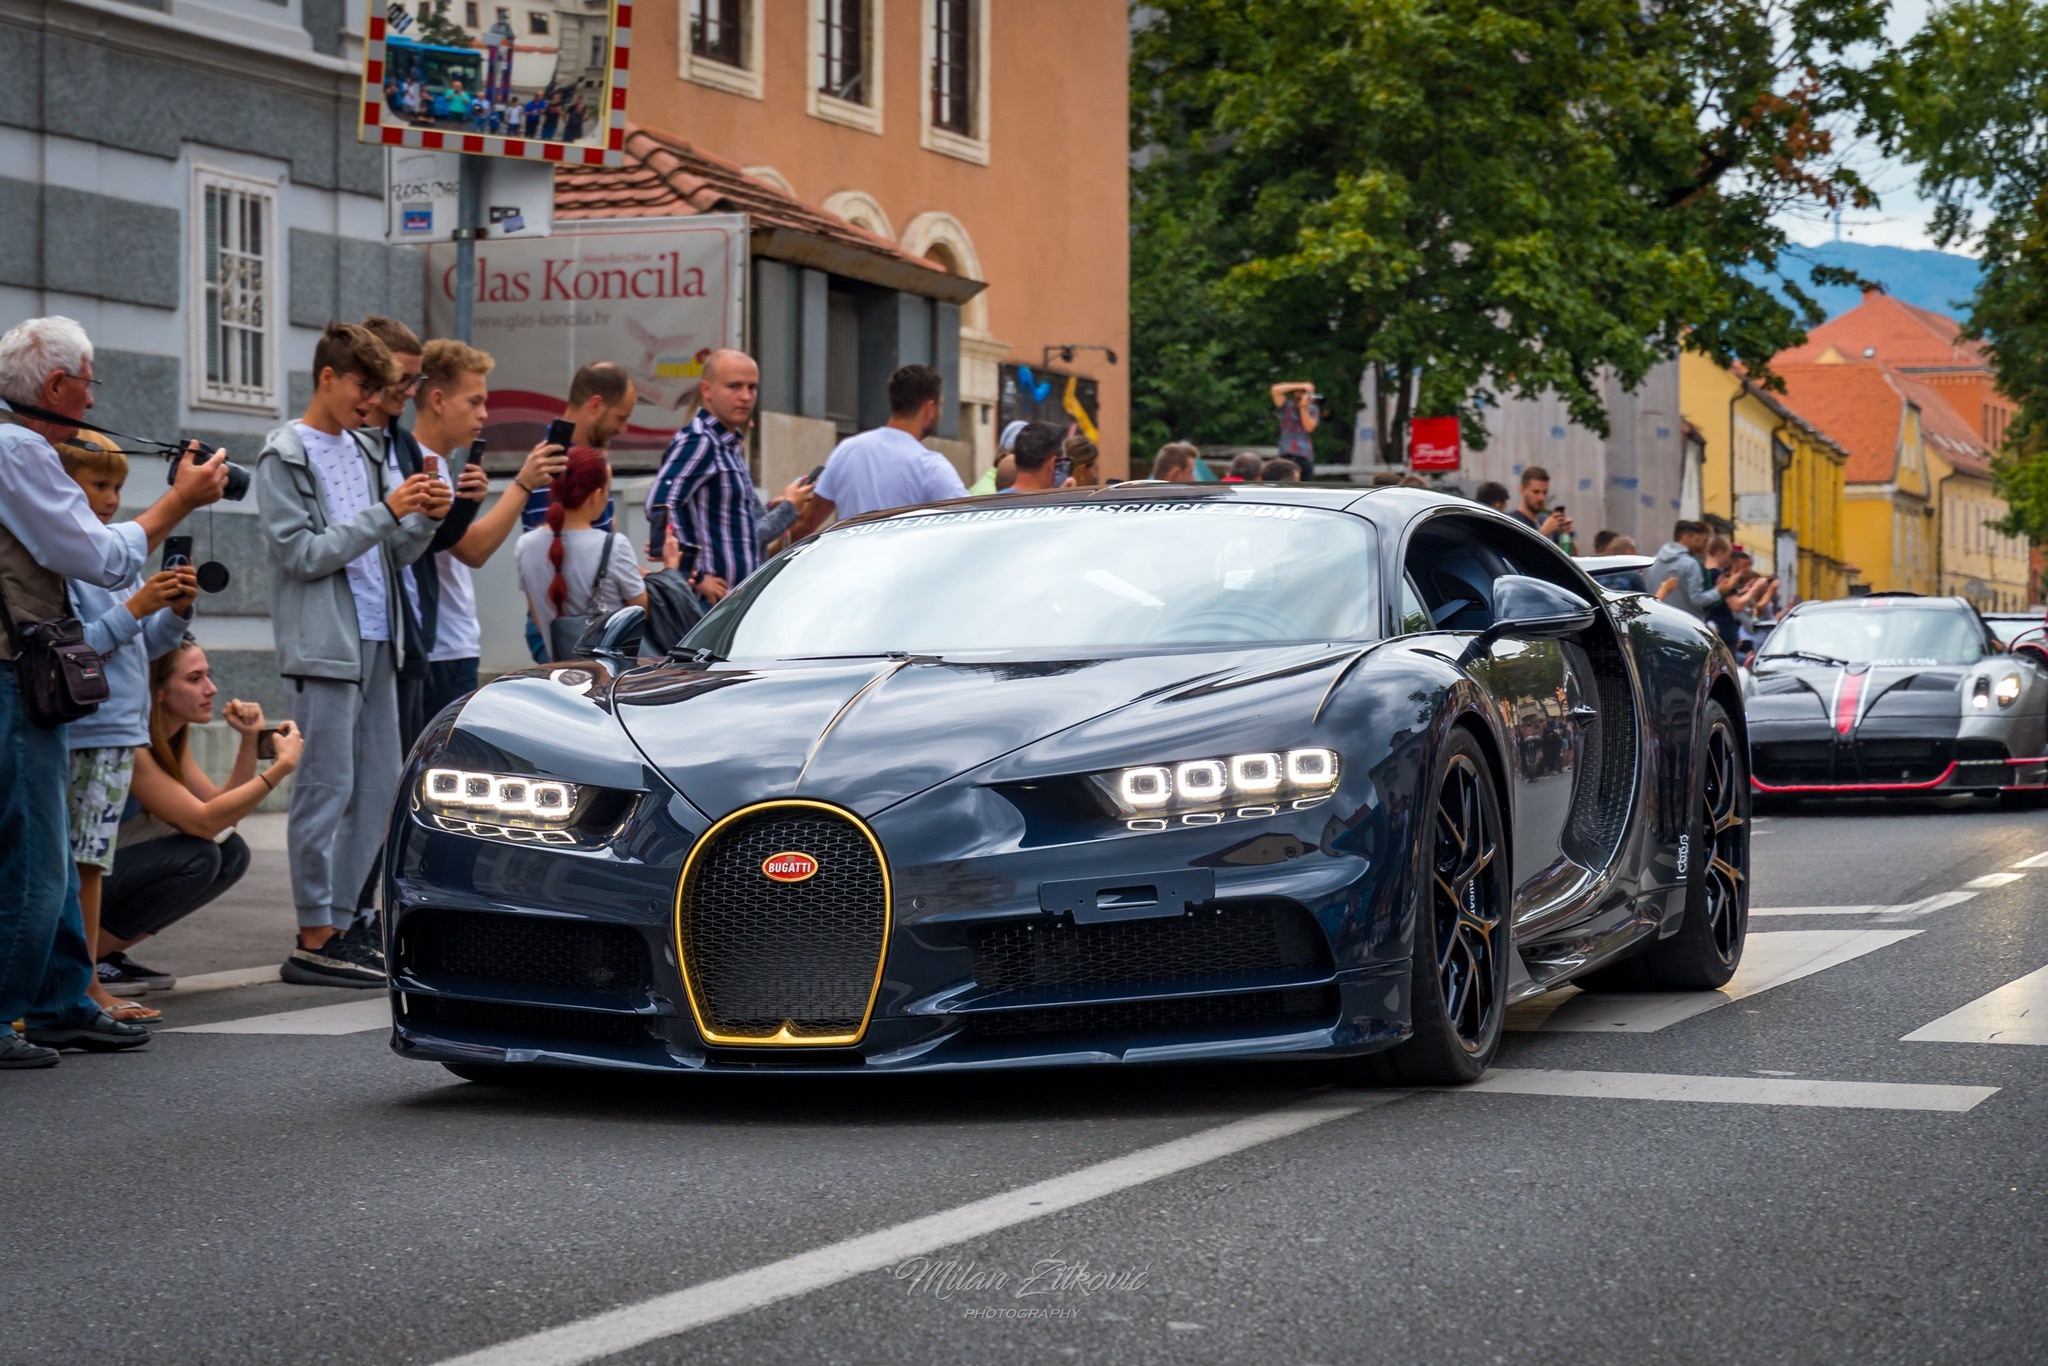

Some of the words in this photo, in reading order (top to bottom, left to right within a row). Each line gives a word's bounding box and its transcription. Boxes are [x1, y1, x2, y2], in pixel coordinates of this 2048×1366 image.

[542, 252, 707, 301] Koncila
[841, 503, 1305, 539] SUPERCAROWNERSCIRCLE.COM
[768, 862, 811, 873] BUGATTI
